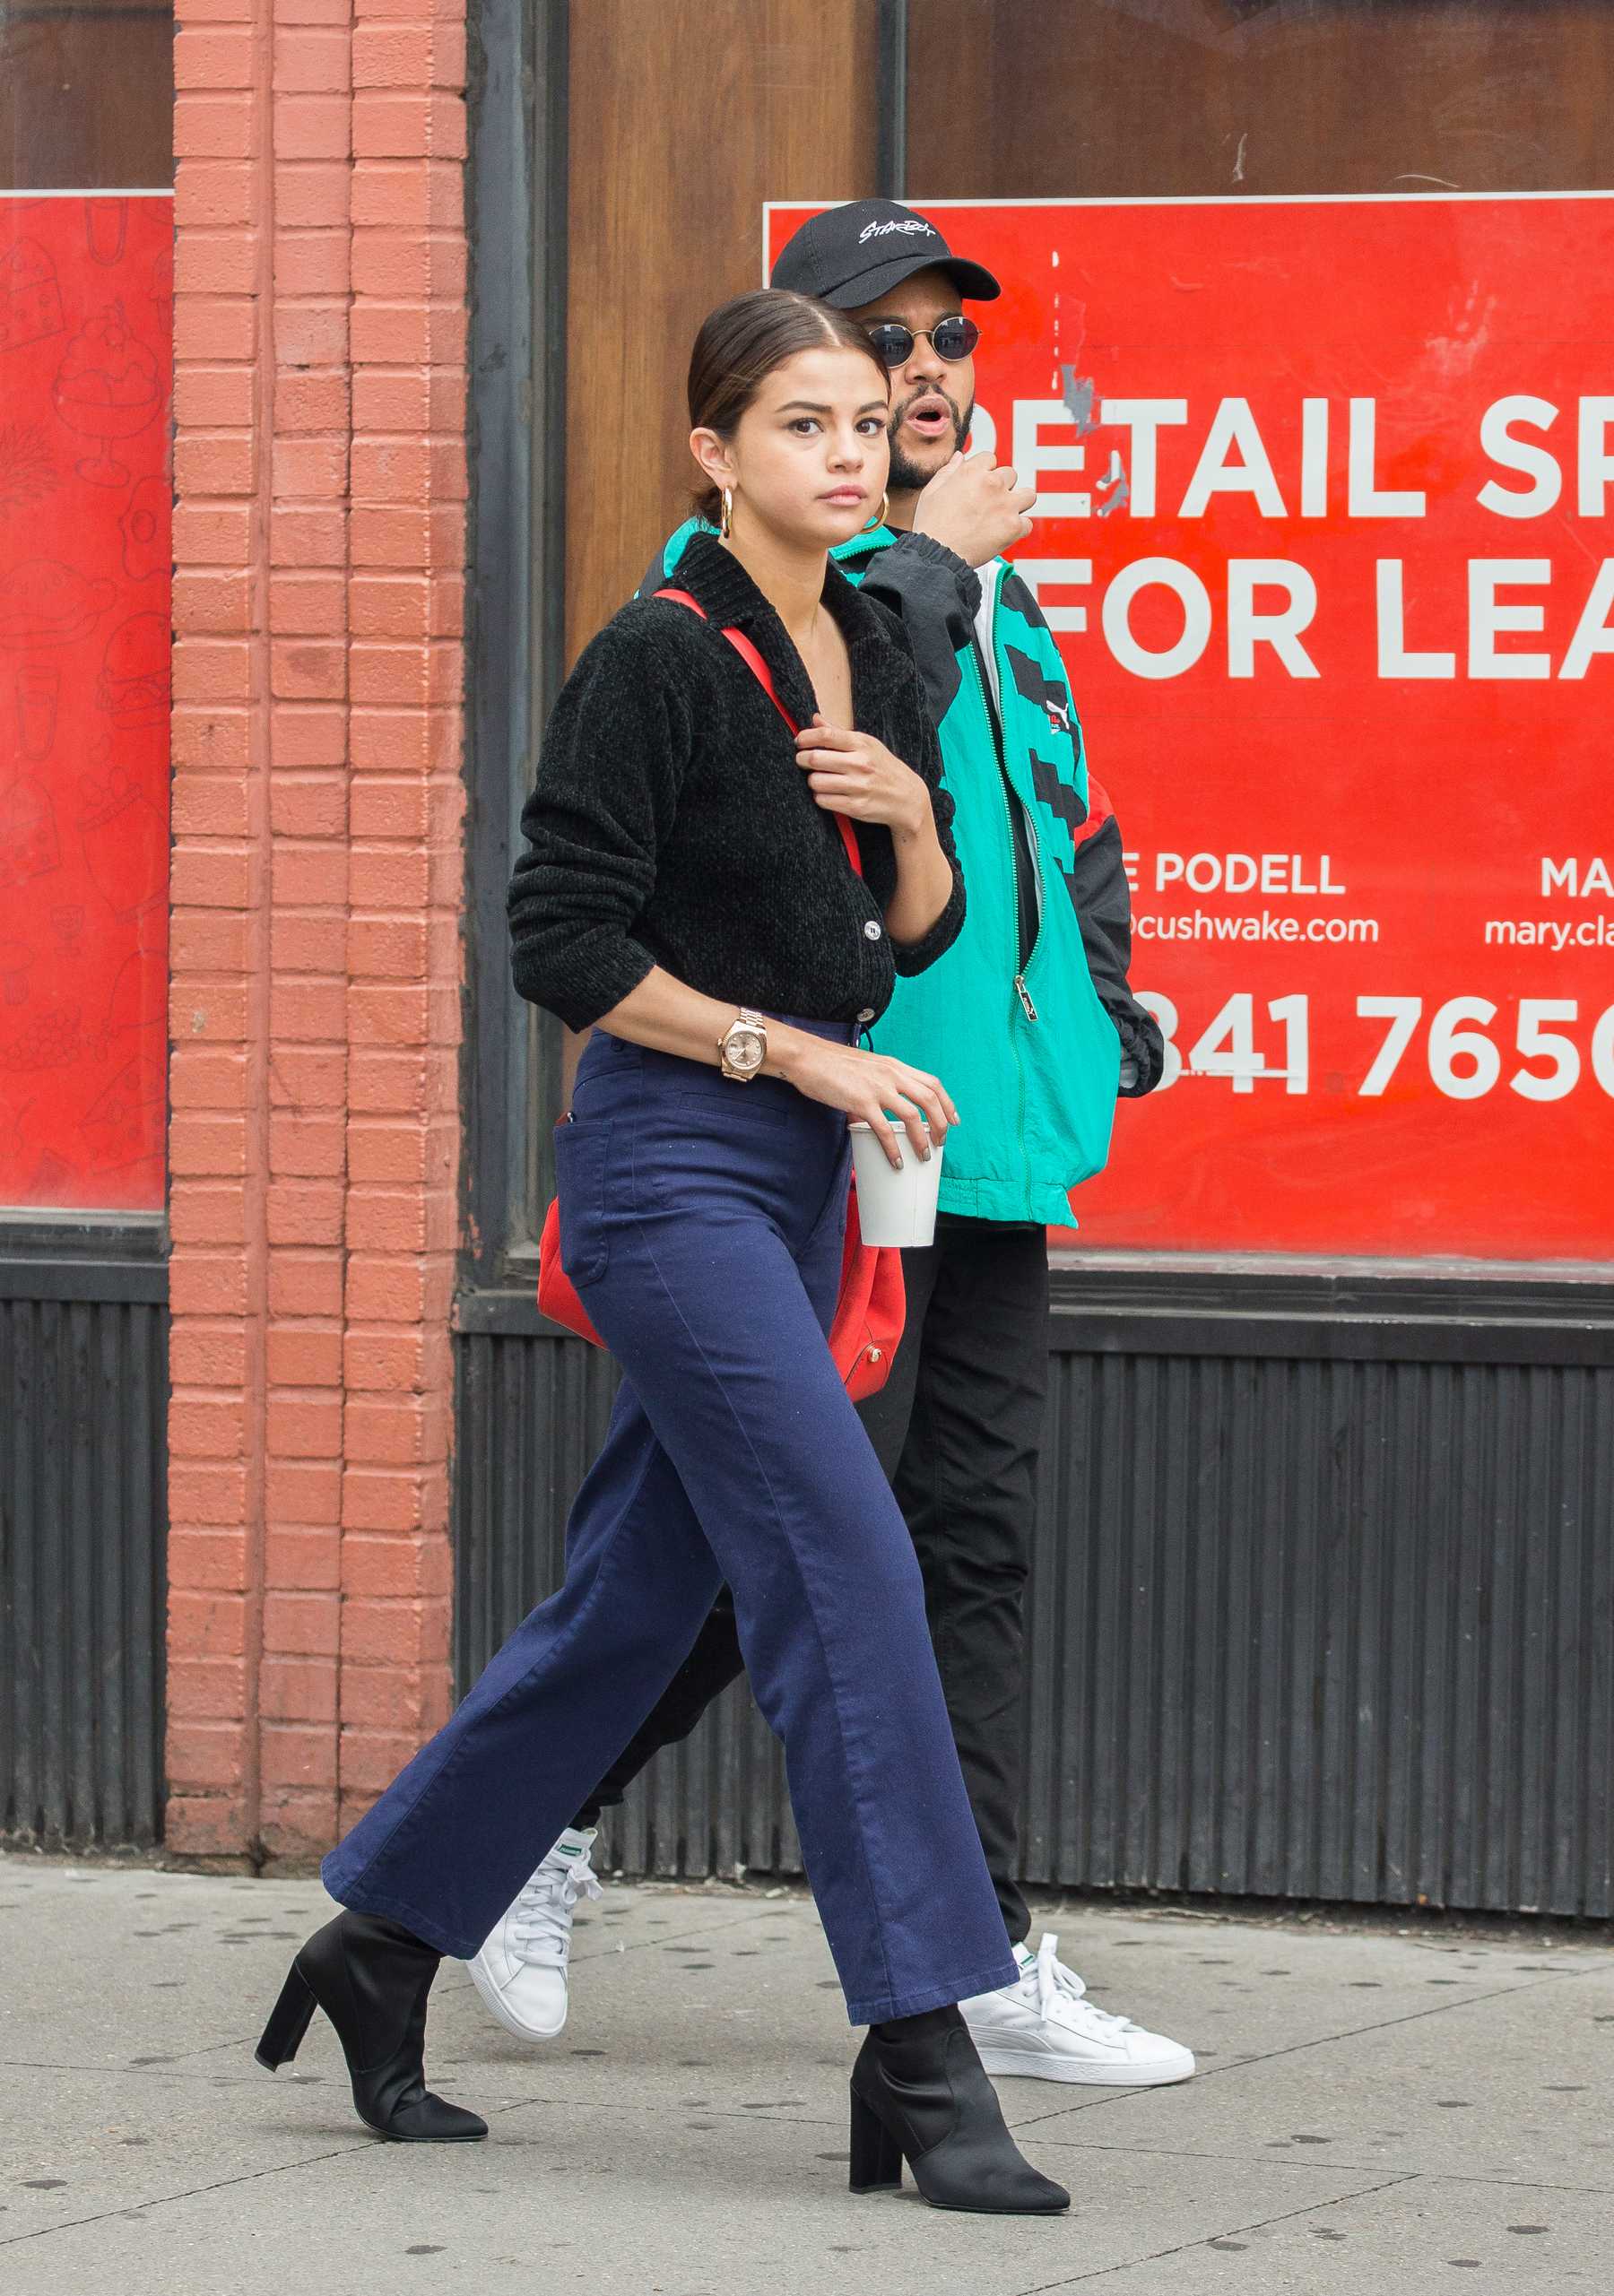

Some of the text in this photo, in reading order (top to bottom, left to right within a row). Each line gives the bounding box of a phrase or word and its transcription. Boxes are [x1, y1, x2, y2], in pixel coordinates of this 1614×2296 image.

[969, 397, 1427, 518] ETAIL
[1012, 557, 1321, 680] FOR
[1155, 853, 1346, 895] PODELL
[1541, 857, 1614, 897] MA
[1131, 909, 1379, 942] cushwake.com
